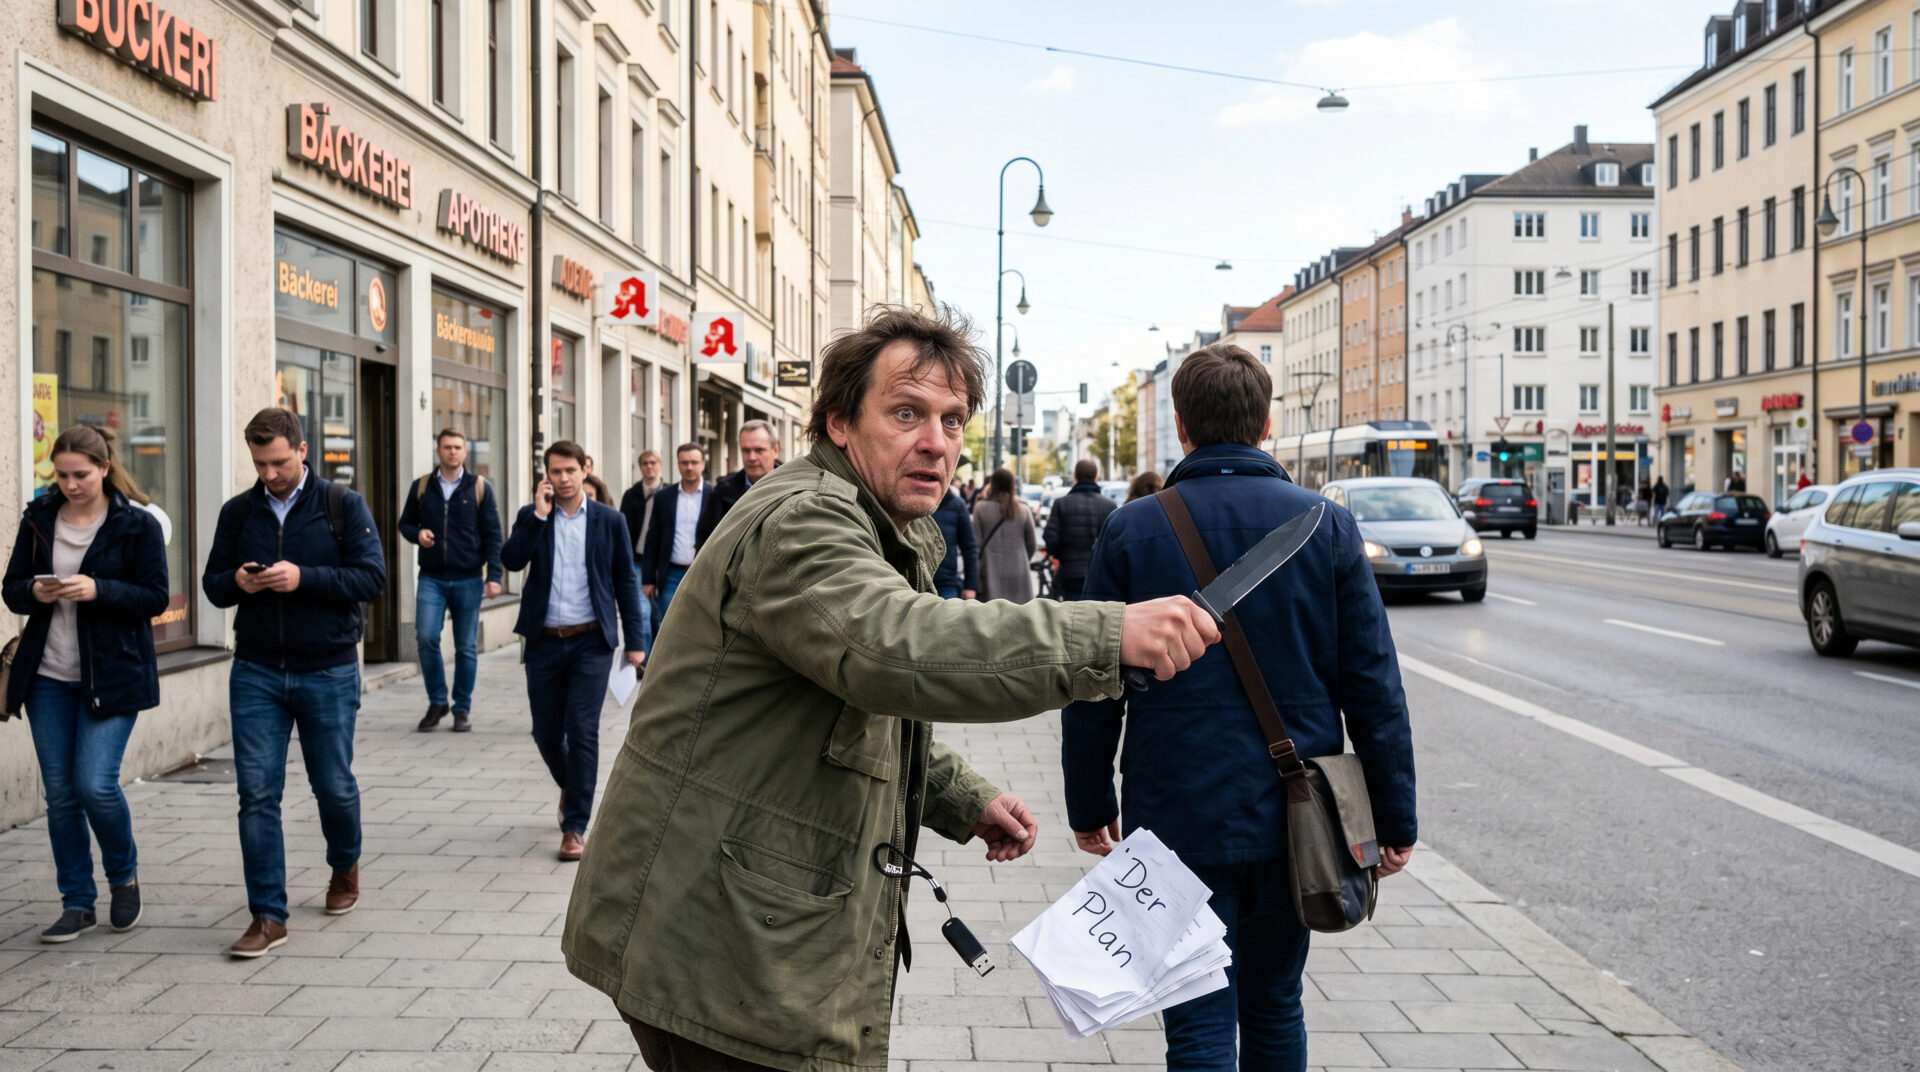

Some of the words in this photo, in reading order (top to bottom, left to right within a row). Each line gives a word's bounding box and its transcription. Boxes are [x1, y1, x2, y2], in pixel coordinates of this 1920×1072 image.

[300, 103, 415, 210] BÄCKEREI
[447, 188, 527, 265] APOTHEKE
[278, 261, 339, 310] Bäckerei
[1113, 857, 1167, 913] Der
[1072, 890, 1132, 968] Plan
